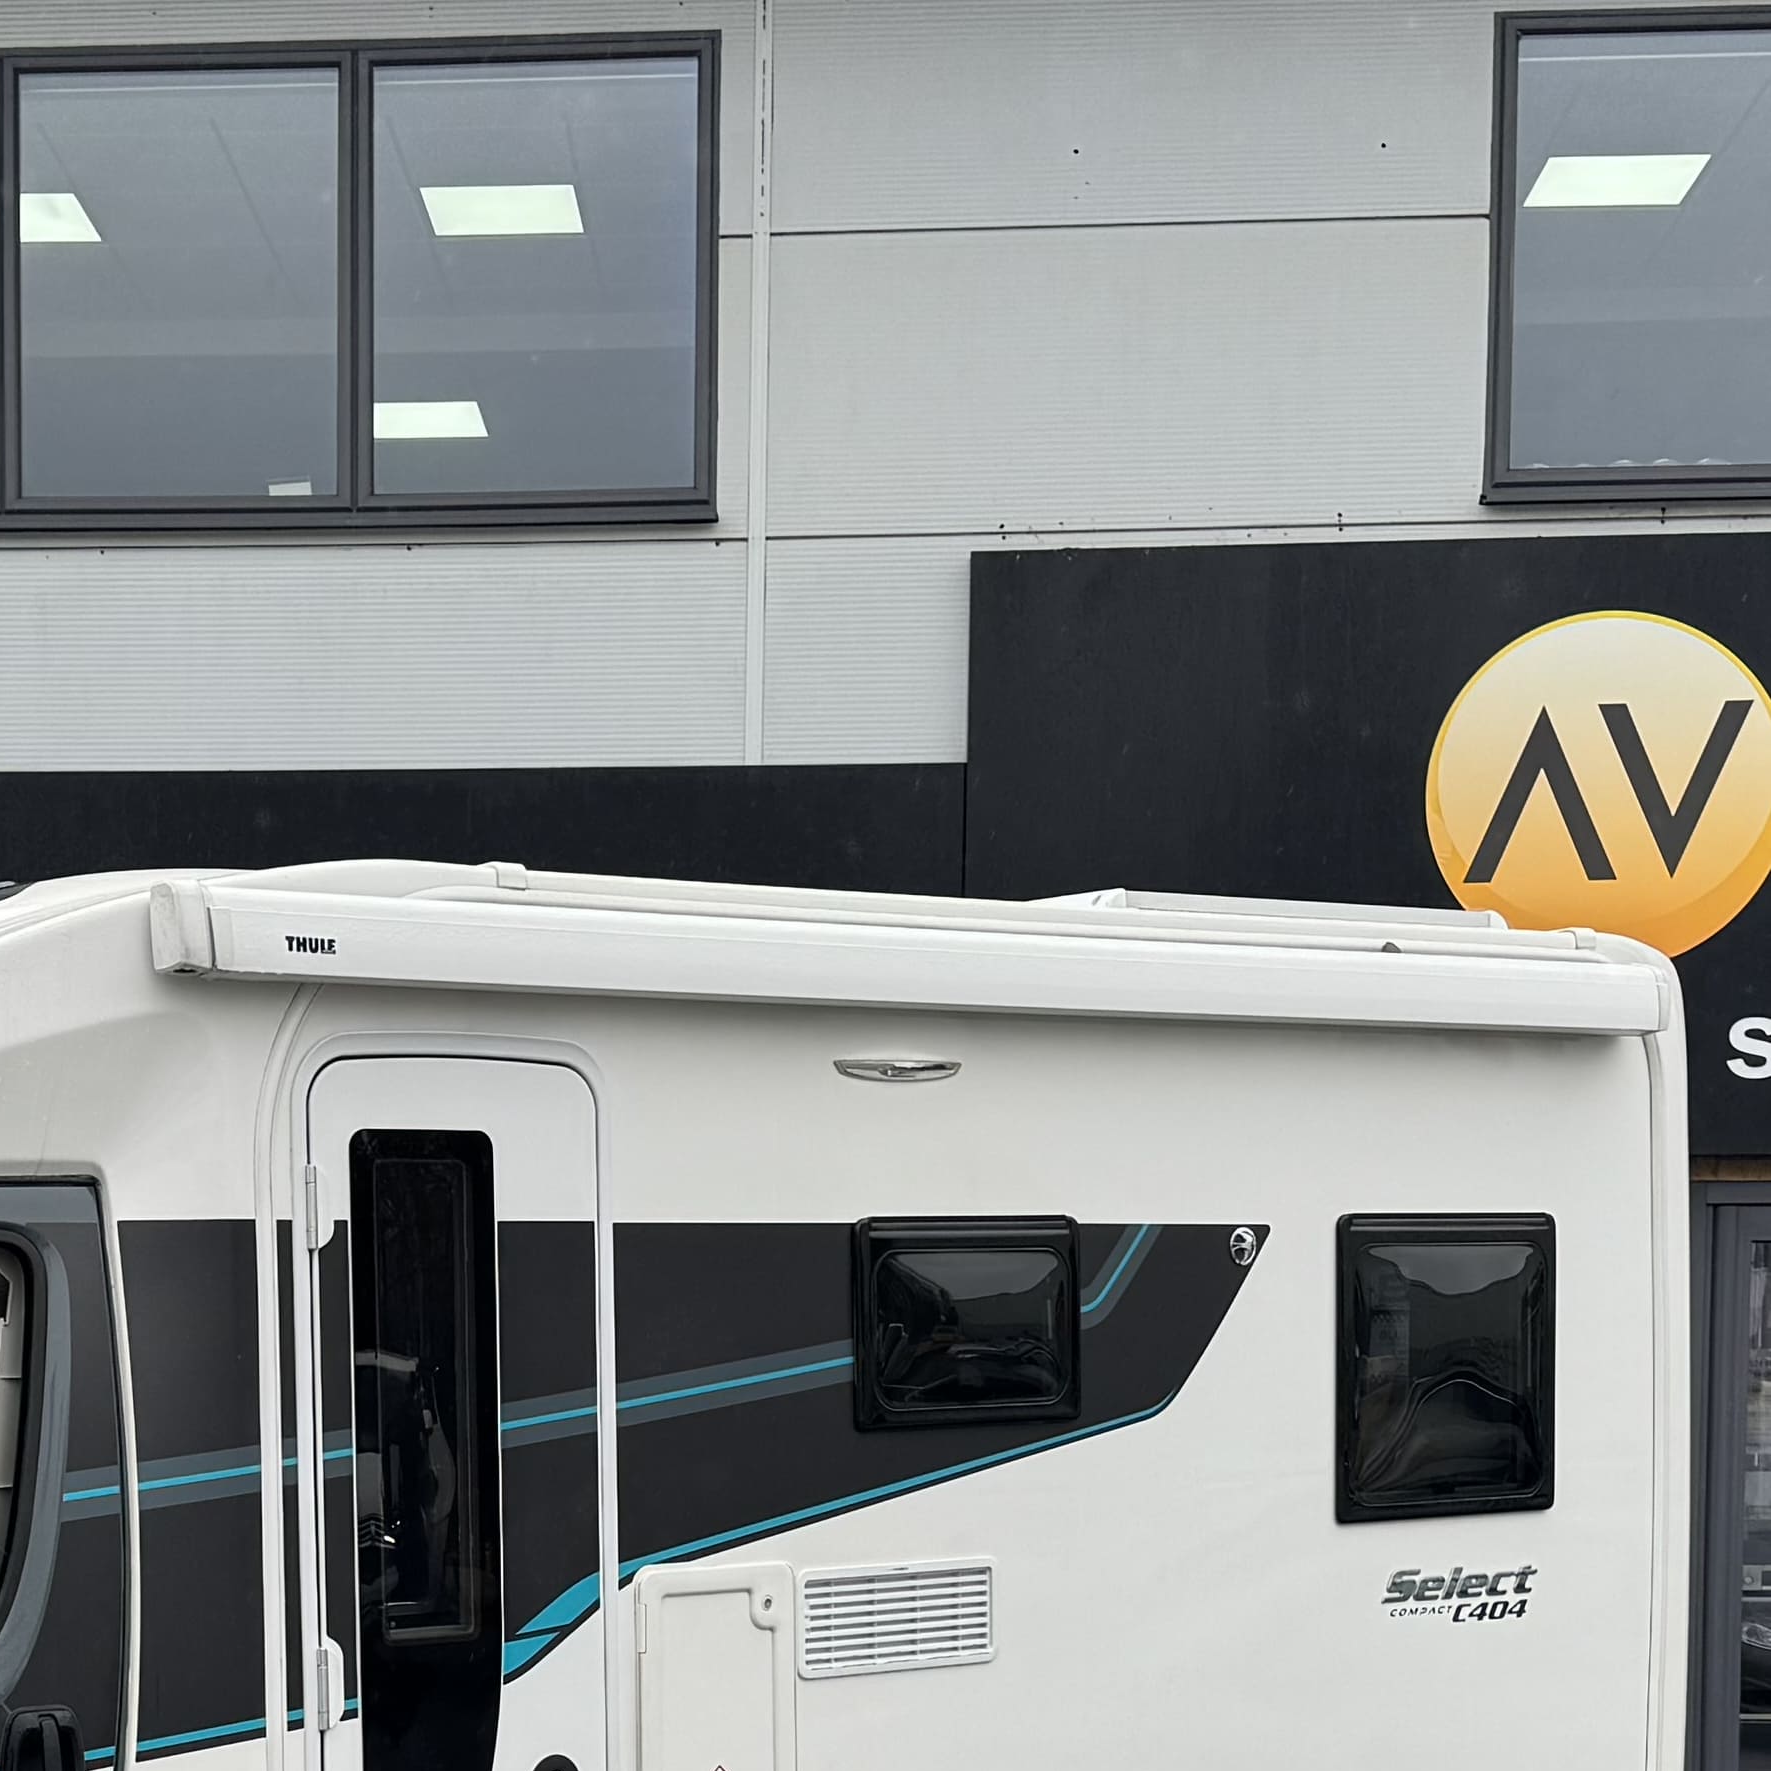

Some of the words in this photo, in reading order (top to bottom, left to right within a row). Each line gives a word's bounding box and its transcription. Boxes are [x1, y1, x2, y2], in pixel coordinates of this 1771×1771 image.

[285, 935, 336, 955] THULE
[1381, 1565, 1538, 1604] Select
[1389, 1605, 1453, 1617] COMPACT
[1452, 1599, 1528, 1623] C404
